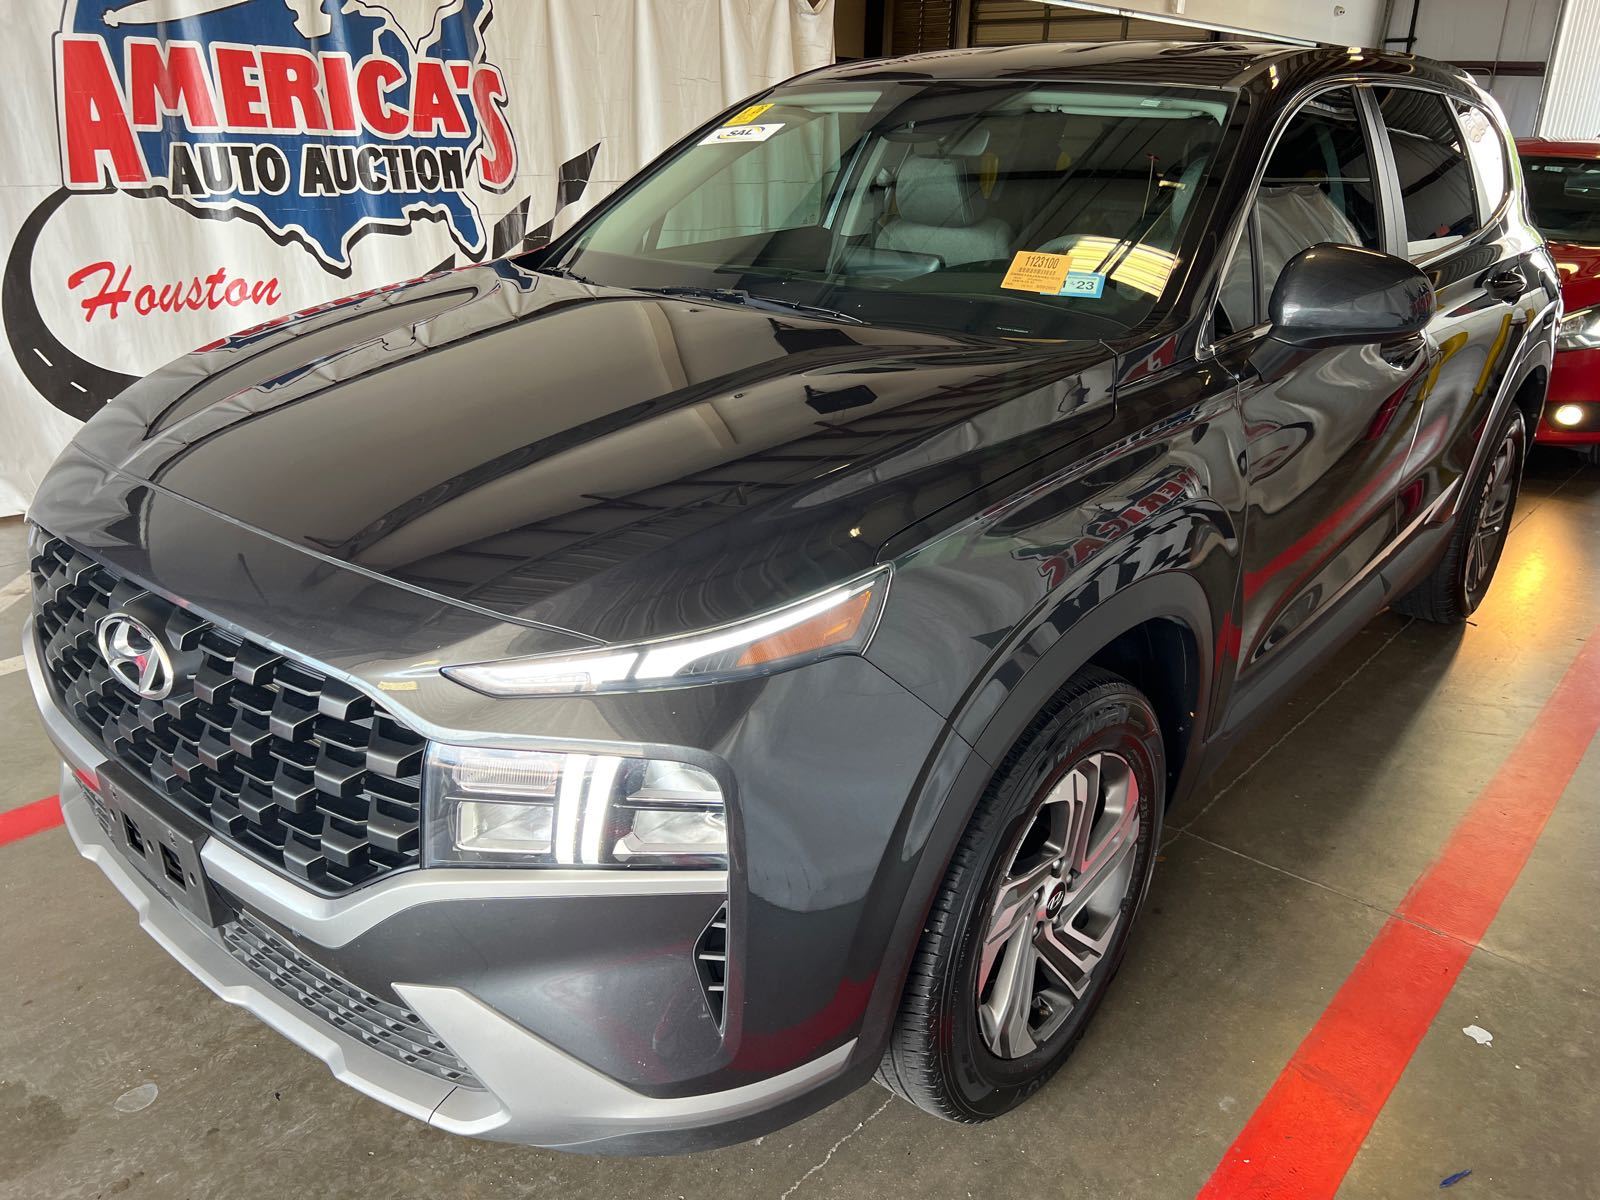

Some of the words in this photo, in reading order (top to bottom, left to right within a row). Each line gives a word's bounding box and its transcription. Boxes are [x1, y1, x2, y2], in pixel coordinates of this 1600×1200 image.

[62, 39, 514, 185] AMERICA'S
[171, 145, 287, 195] AUTO
[303, 146, 464, 195] AUCTION
[1025, 255, 1060, 269] 1123100
[1076, 280, 1095, 290] 23
[67, 261, 282, 322] Houston
